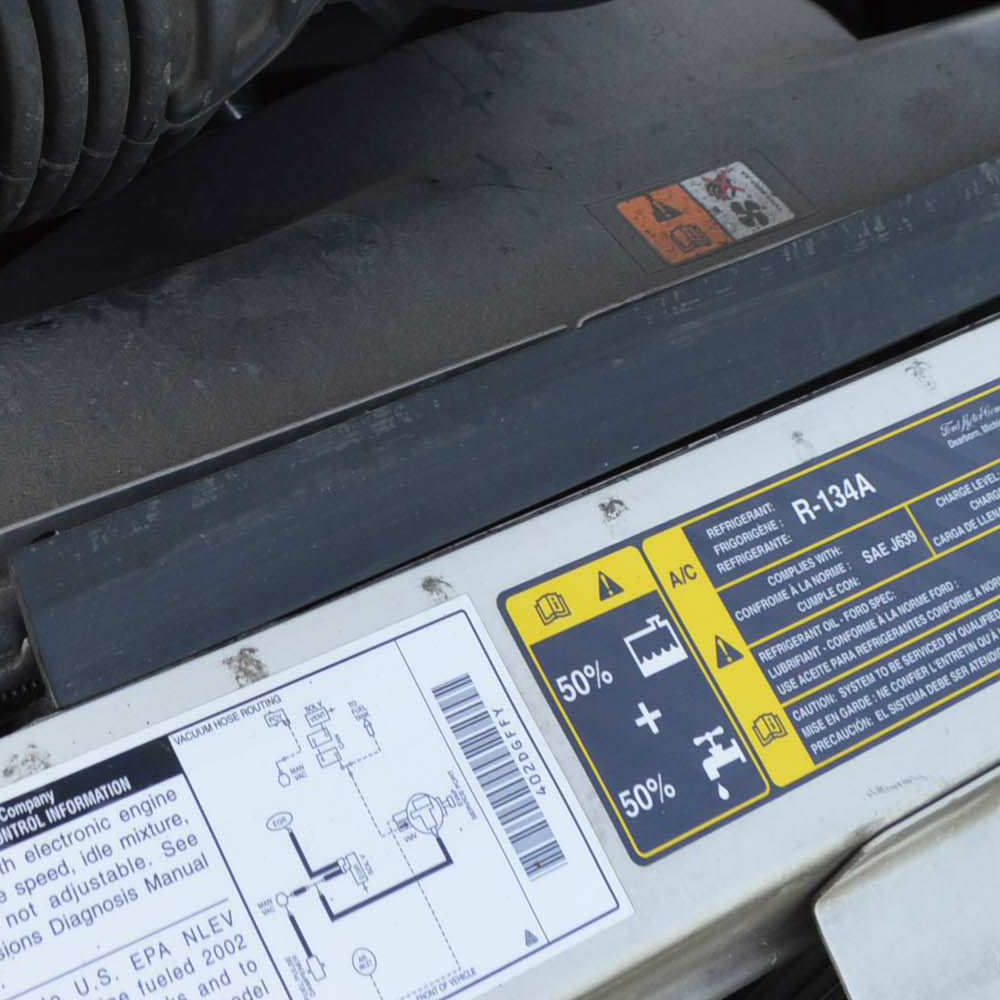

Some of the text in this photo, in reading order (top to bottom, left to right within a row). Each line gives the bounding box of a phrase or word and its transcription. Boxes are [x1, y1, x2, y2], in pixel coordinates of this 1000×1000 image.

[706, 502, 775, 539] REFRIGERANT:
[791, 473, 876, 524] R-134A
[935, 484, 973, 508] CHARGE
[716, 534, 793, 574] REFRIGERANTE:
[861, 529, 918, 564] SAE J639
[933, 525, 966, 547] CARGA
[963, 518, 979, 533] DE
[669, 563, 698, 589] A/C
[735, 589, 790, 622] CONFROME
[797, 579, 813, 593] LA
[810, 562, 847, 586] NORME
[767, 546, 843, 586] COMPLIES WITH:
[796, 577, 861, 613] CUMPLE CON:
[758, 590, 897, 663] REFRIGERANT OIL FORD SPEC:
[767, 645, 821, 679] LUBRIFIANT
[826, 618, 878, 650] CONFORME
[884, 608, 900, 622] LA
[896, 592, 931, 615] NORME
[928, 581, 954, 600] FORD
[776, 678, 799, 695] USE
[798, 661, 832, 686] ACEITE
[829, 649, 857, 669] PARA
[854, 614, 928, 657] REFRIGERANTES
[926, 590, 976, 621] CONFORME
[974, 587, 983, 598] A
[556, 660, 613, 702] 50%
[792, 693, 837, 722] CAUTION:
[838, 672, 876, 698] SYSTEM
[873, 665, 889, 679] TO
[887, 658, 903, 673] BE
[901, 637, 946, 666] SERVICED
[943, 630, 958, 645] BY
[801, 718, 827, 738] MISE
[824, 711, 841, 726] EN
[839, 694, 873, 719] GARDE
[876, 685, 891, 700] NE
[890, 665, 930, 693] CONFIER
[874, 708, 890, 722] EL
[887, 688, 928, 715] SISTEMA
[925, 675, 952, 695] DEBE
[949, 665, 970, 682] SER
[173, 694, 282, 745] VACUUM HOSE ROUTING
[492, 708, 547, 796] 402DGFFY
[45, 776, 132, 823] INFORMATION
[618, 773, 676, 818] 50%
[24, 817, 112, 863] electronic
[119, 789, 177, 823] engine
[5, 902, 38, 929] not
[48, 857, 153, 909] adjustable.
[161, 833, 199, 858] See
[14, 858, 76, 896] speed,
[79, 844, 113, 867] idle
[119, 813, 189, 850] mixture,
[48, 888, 139, 936] Diagnosis
[143, 852, 209, 894] Manual
[73, 909, 233, 997] U.S. EPA NLEV
[137, 933, 247, 997] fueled 2002
[198, 967, 232, 998] and
[238, 959, 258, 977] to
